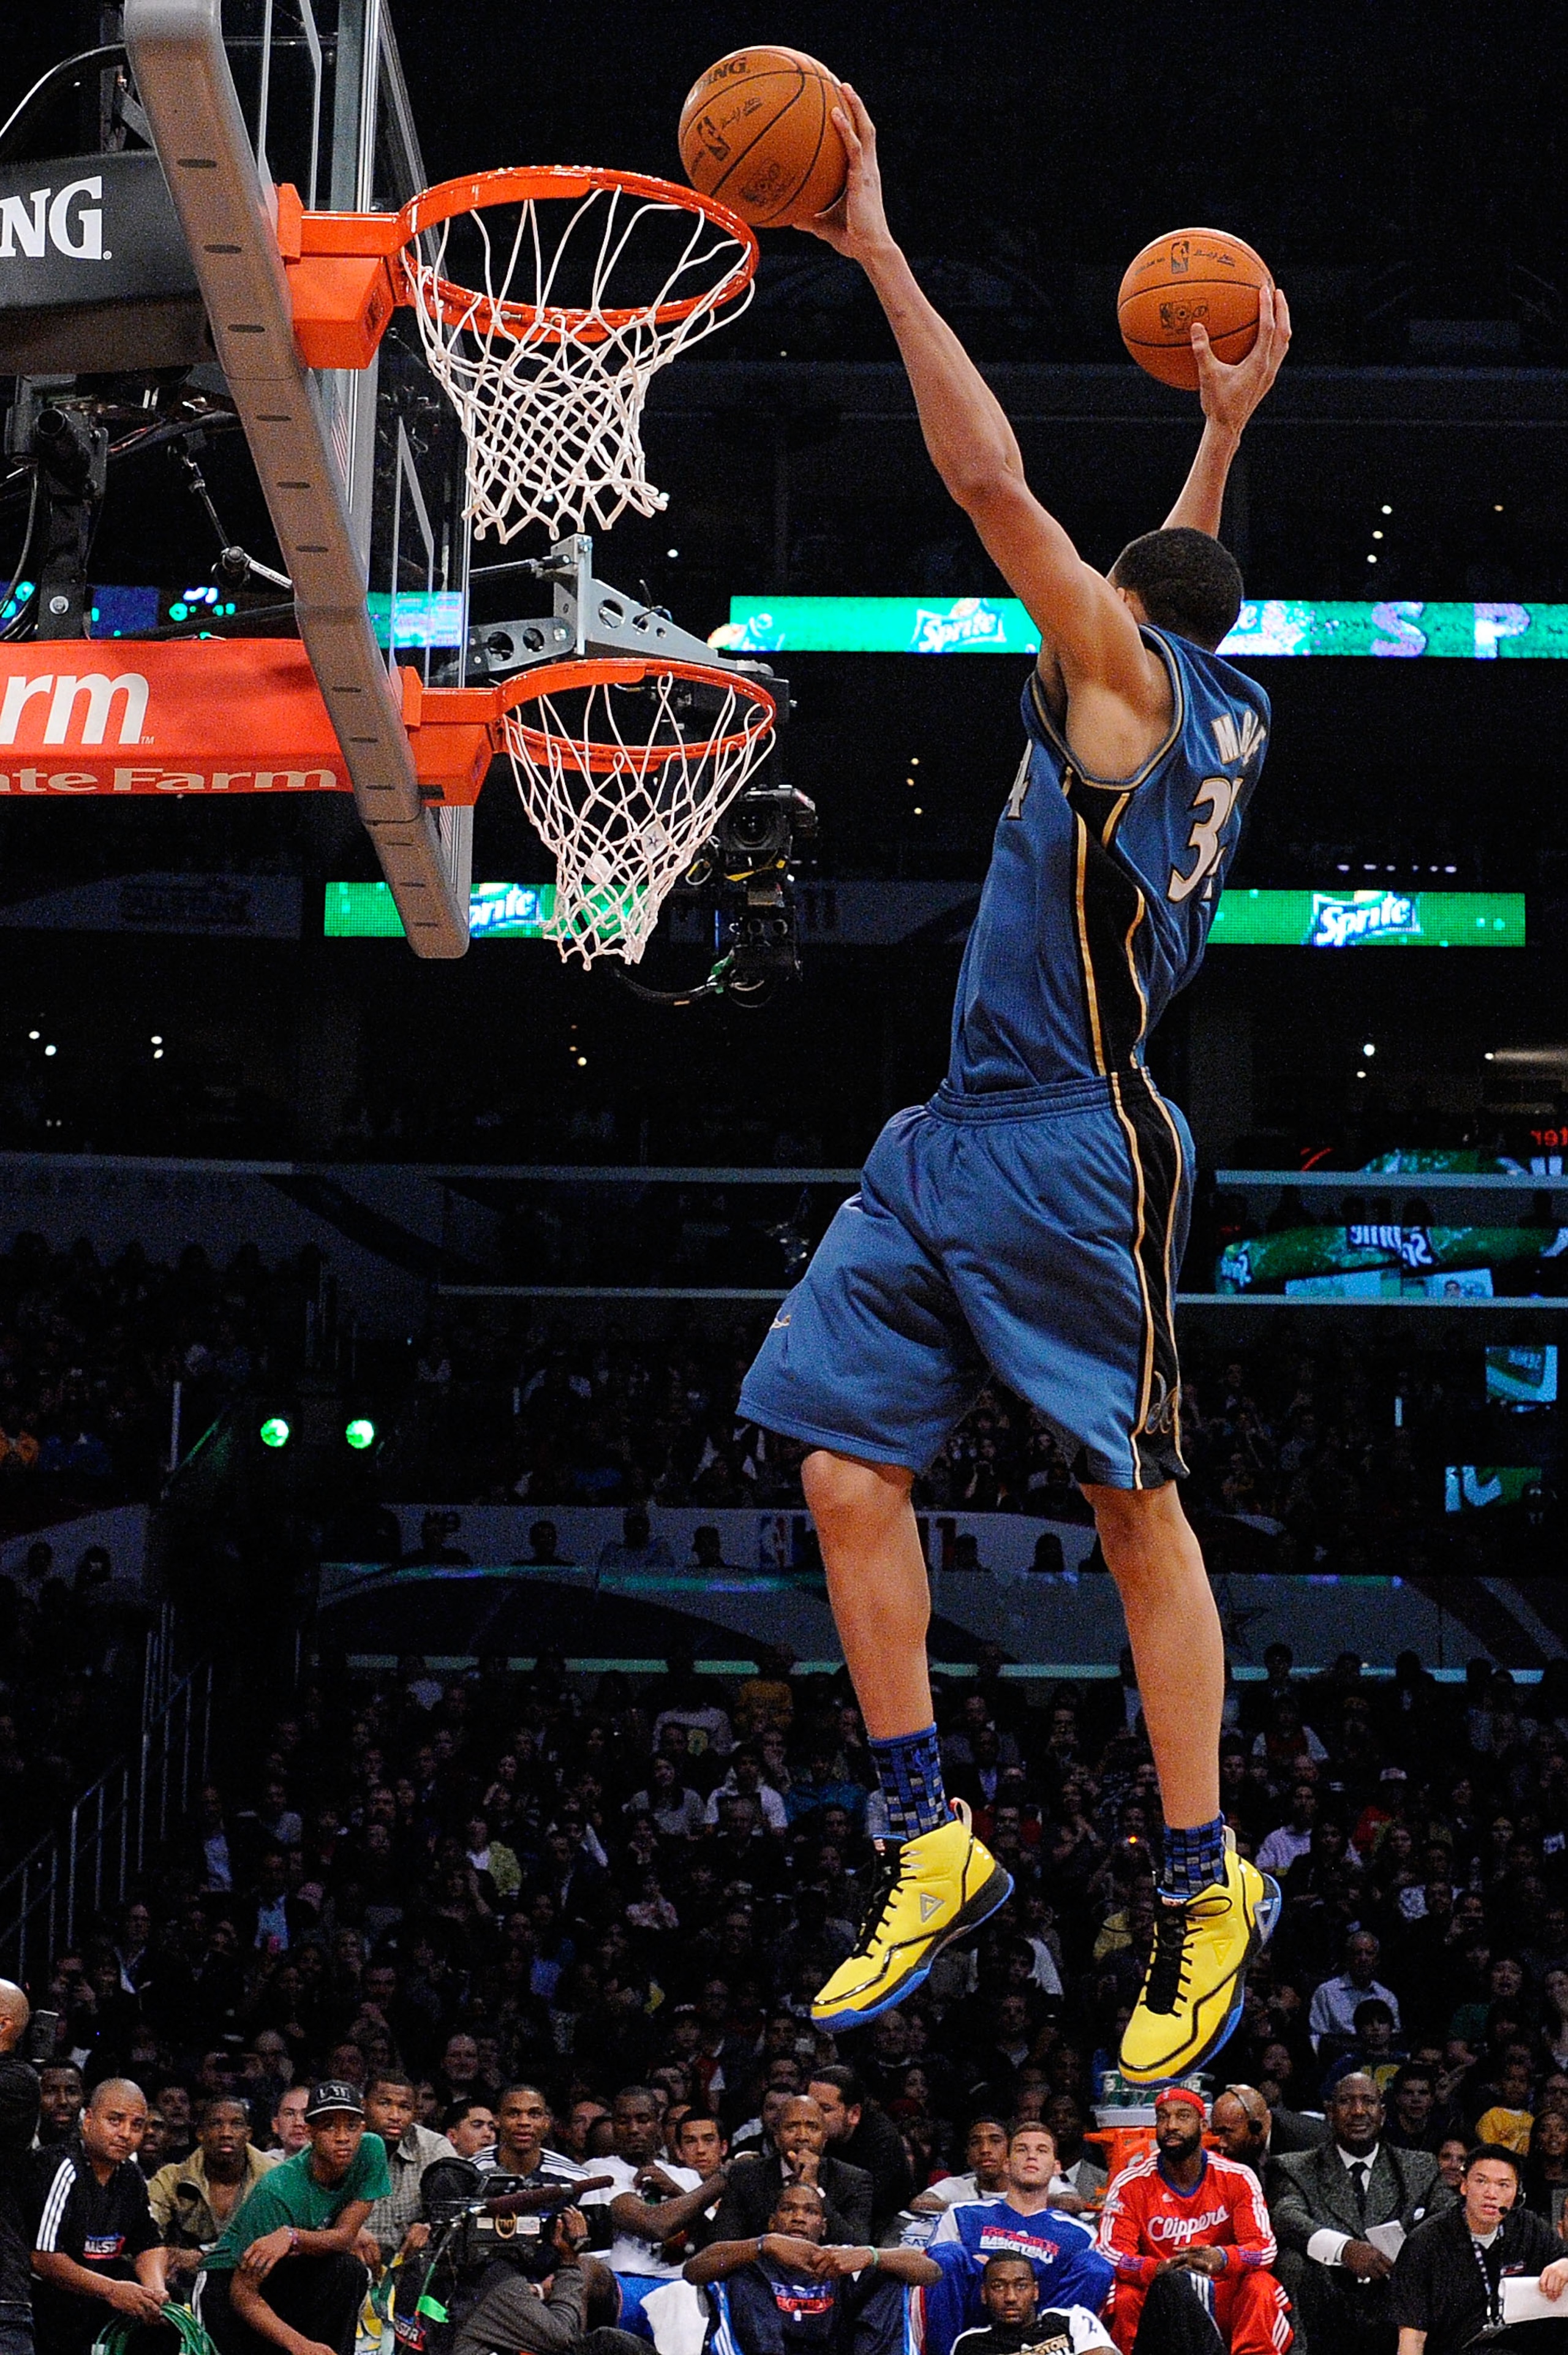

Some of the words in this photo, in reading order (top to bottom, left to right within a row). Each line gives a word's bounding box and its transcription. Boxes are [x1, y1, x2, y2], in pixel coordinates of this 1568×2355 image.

[114, 768, 337, 791] Farm
[1316, 891, 1411, 946] Sprite
[1148, 2205, 1229, 2245] Clippers
[1081, 2315, 1098, 2334] 2
